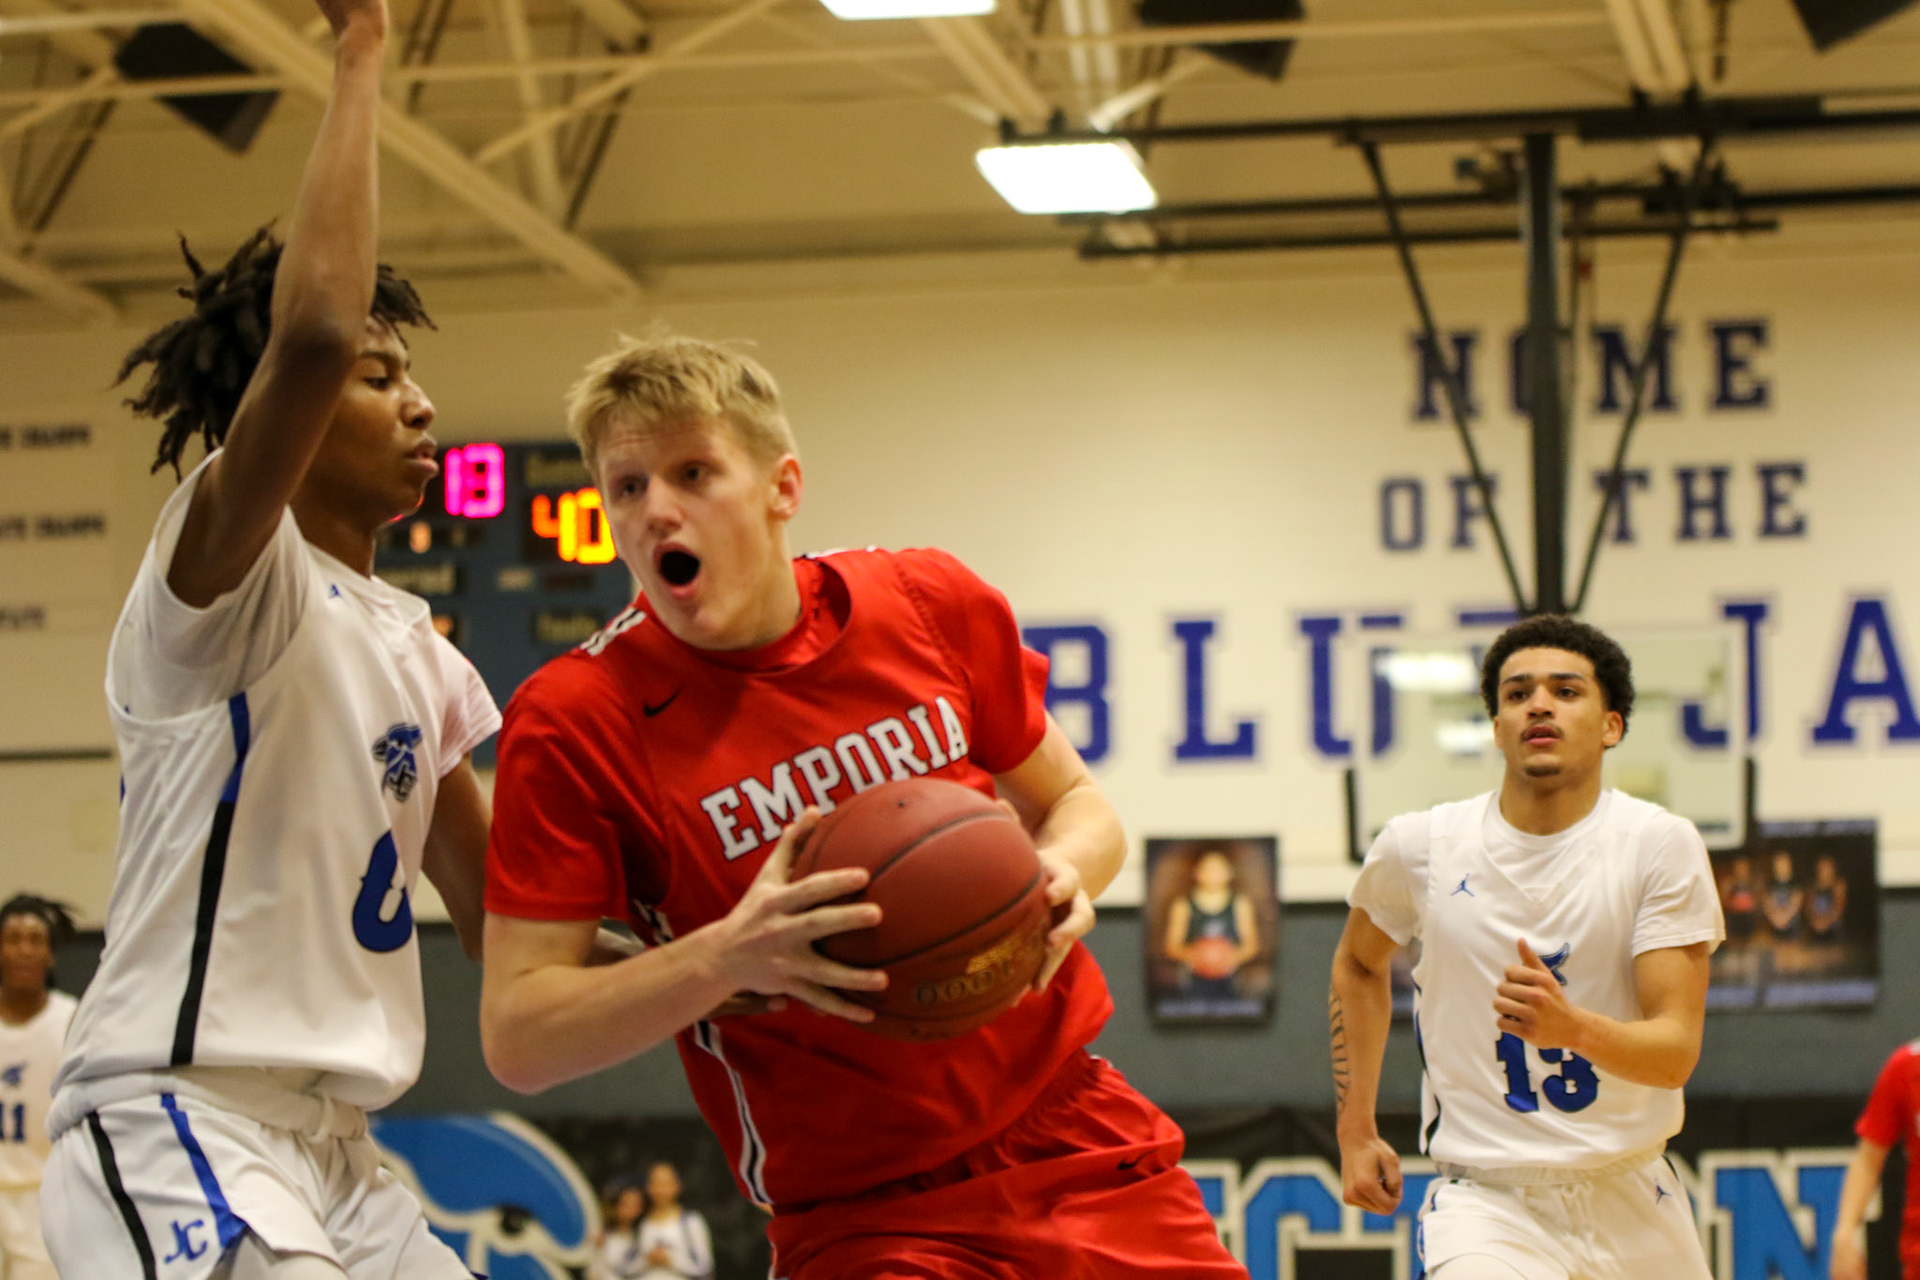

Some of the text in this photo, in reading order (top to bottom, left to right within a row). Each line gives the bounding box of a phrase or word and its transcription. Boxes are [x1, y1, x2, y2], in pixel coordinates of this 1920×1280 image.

[532, 487, 617, 564] 40
[1380, 461, 1806, 549] OF THE
[1022, 610, 1524, 764] BLU
[700, 695, 969, 861] EMPORIA
[1495, 1030, 1600, 1113] 13
